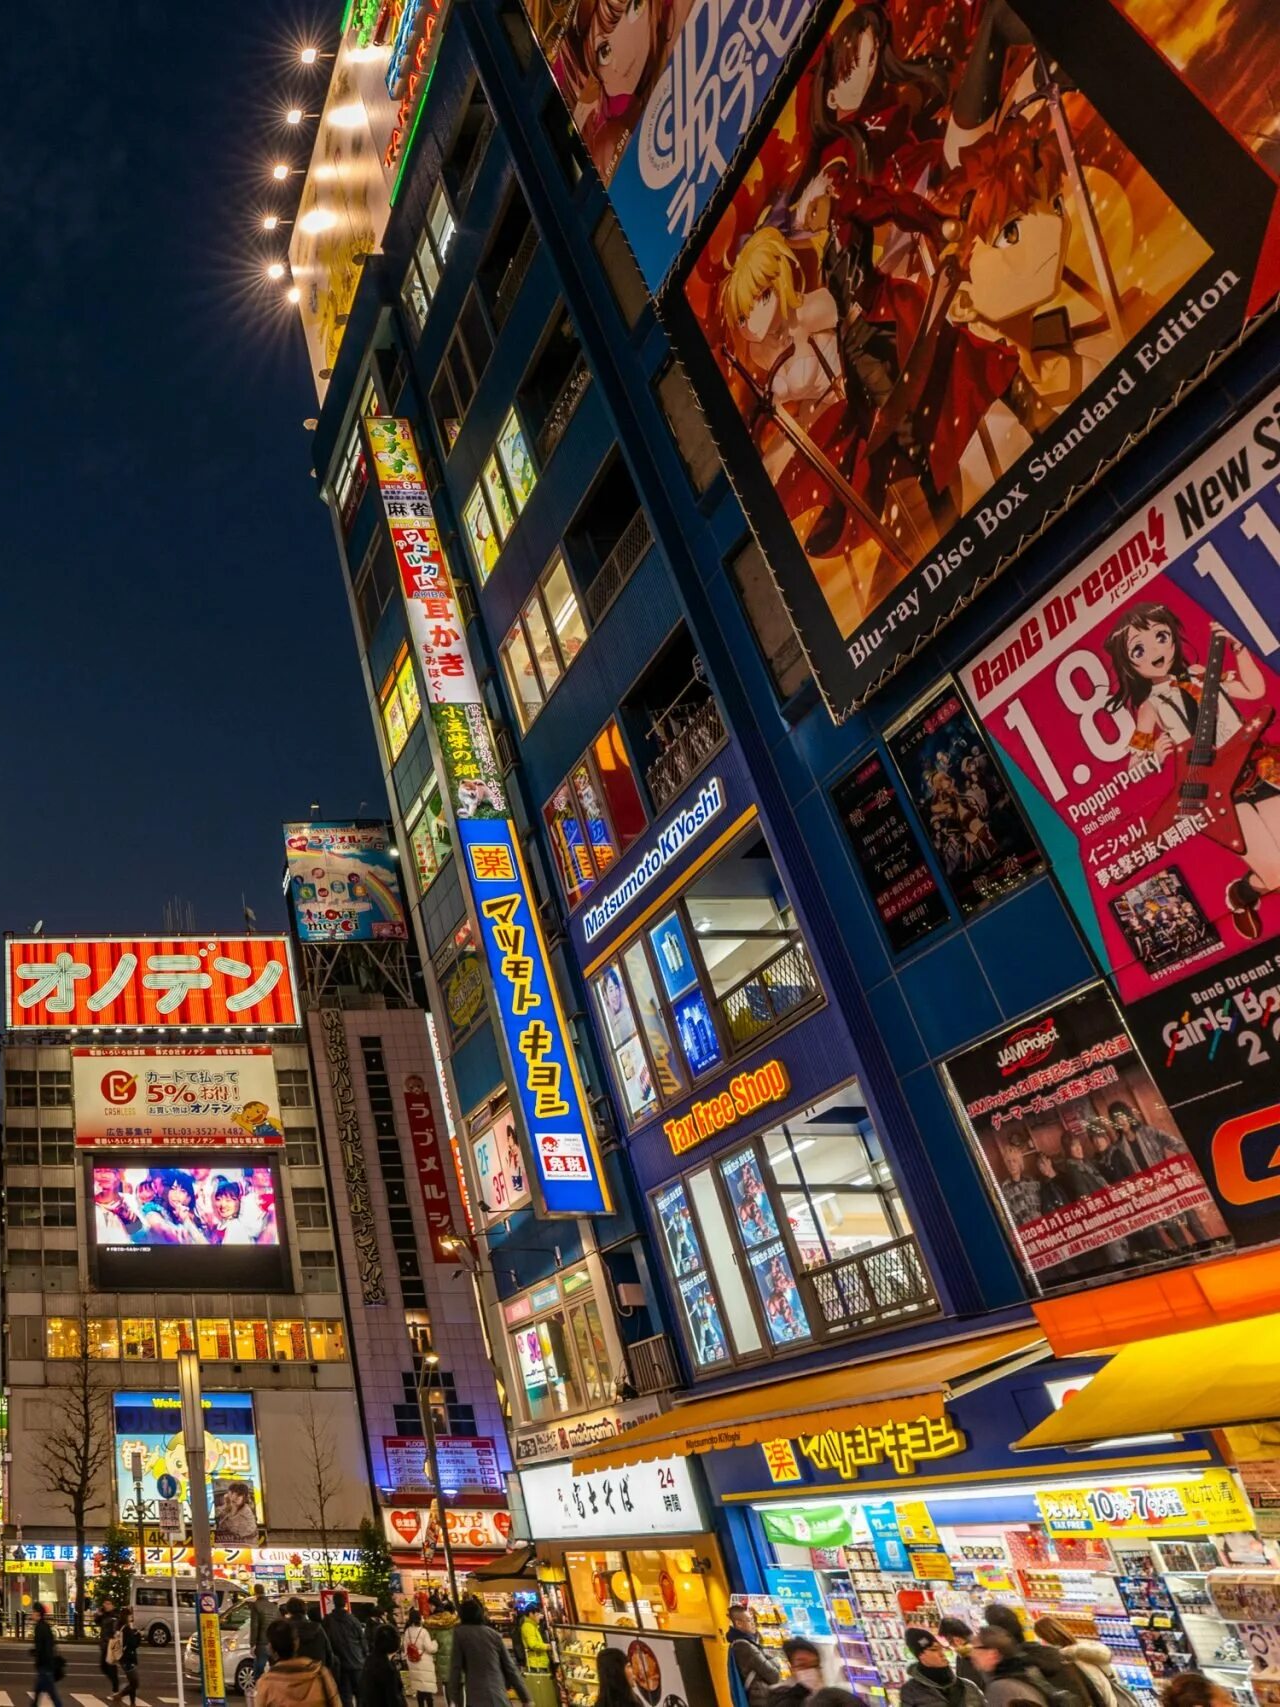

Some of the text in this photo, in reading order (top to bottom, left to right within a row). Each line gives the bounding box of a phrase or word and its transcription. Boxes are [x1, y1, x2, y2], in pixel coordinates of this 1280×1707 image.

[847, 586, 921, 670] Blu-ray
[920, 538, 976, 594] Disc
[974, 482, 1030, 540] Box
[1027, 369, 1137, 483] Standard
[1133, 268, 1241, 373] Edition
[388, 502, 433, 518] 麻雀
[1174, 440, 1251, 541] New
[970, 505, 1168, 702] BanG Dream!
[1109, 564, 1150, 605] バンドリ
[422, 599, 465, 678] 耳かき
[423, 641, 446, 705] もみほぐし
[441, 705, 480, 779] 小豆柴の郷
[1004, 649, 1136, 802] 1.8
[1068, 755, 1163, 823] Poppin'Party
[1081, 805, 1122, 837] 15th Single
[474, 846, 512, 877] 薬
[584, 852, 661, 942] Matsumoto
[16, 941, 284, 1014] オノデン
[1191, 982, 1225, 1005] BanG
[481, 894, 569, 1118] マツモトキヨシ
[145, 1071, 239, 1085] カードで払って
[146, 1084, 240, 1104] 5% お得!
[104, 1107, 137, 1117] CASHLESS
[663, 1059, 787, 1156] Tax Free Shop
[106, 1126, 153, 1137] 広告募集中
[409, 1102, 452, 1257] ラブメルシ
[477, 1142, 490, 1176] 2F
[547, 1155, 585, 1173] 免税
[656, 1467, 675, 1489] 24
[1182, 1481, 1236, 1507] 松本清
[24, 1543, 75, 1560] 冷蔵庫
